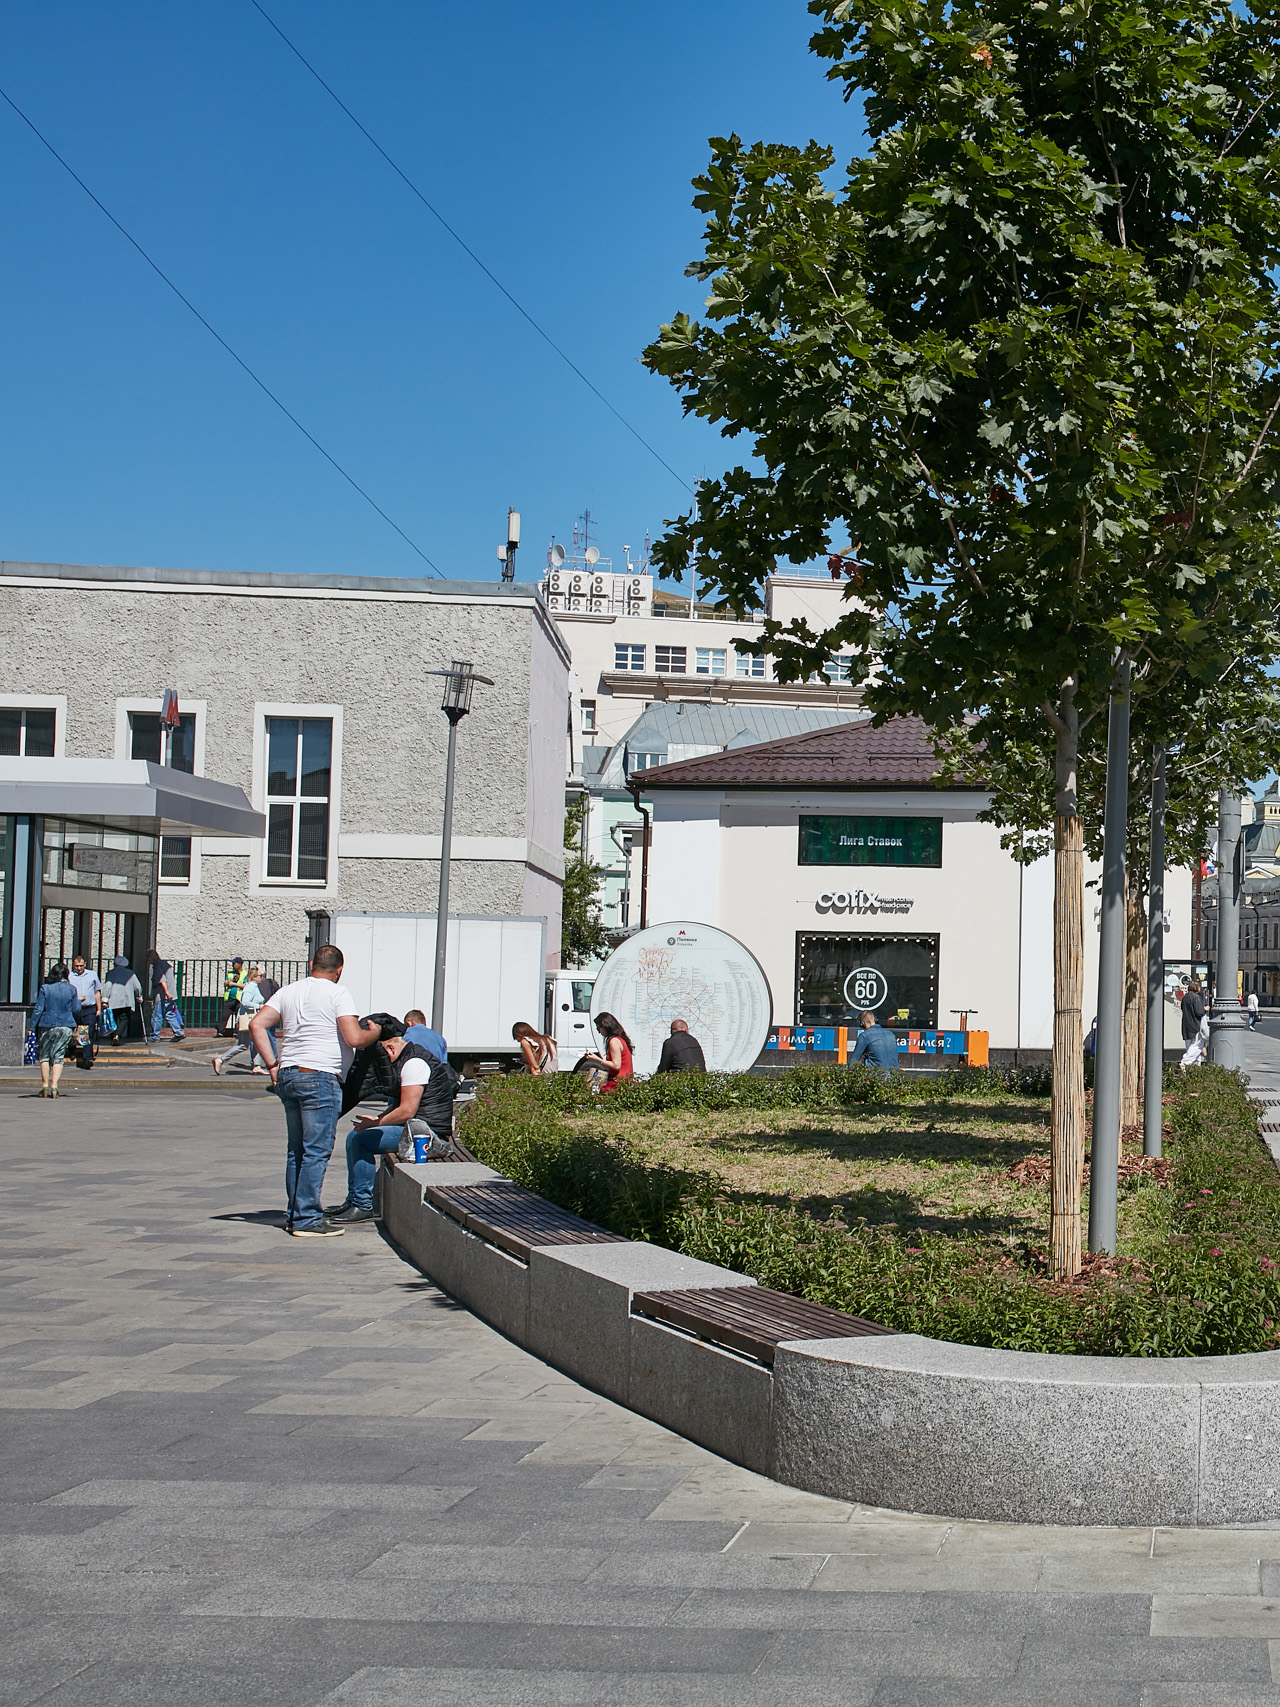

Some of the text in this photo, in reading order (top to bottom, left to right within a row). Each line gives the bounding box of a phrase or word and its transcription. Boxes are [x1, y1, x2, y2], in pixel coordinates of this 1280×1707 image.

[839, 835, 902, 846] Лига Ставок
[817, 887, 880, 908] cofix
[855, 980, 877, 999] 60
